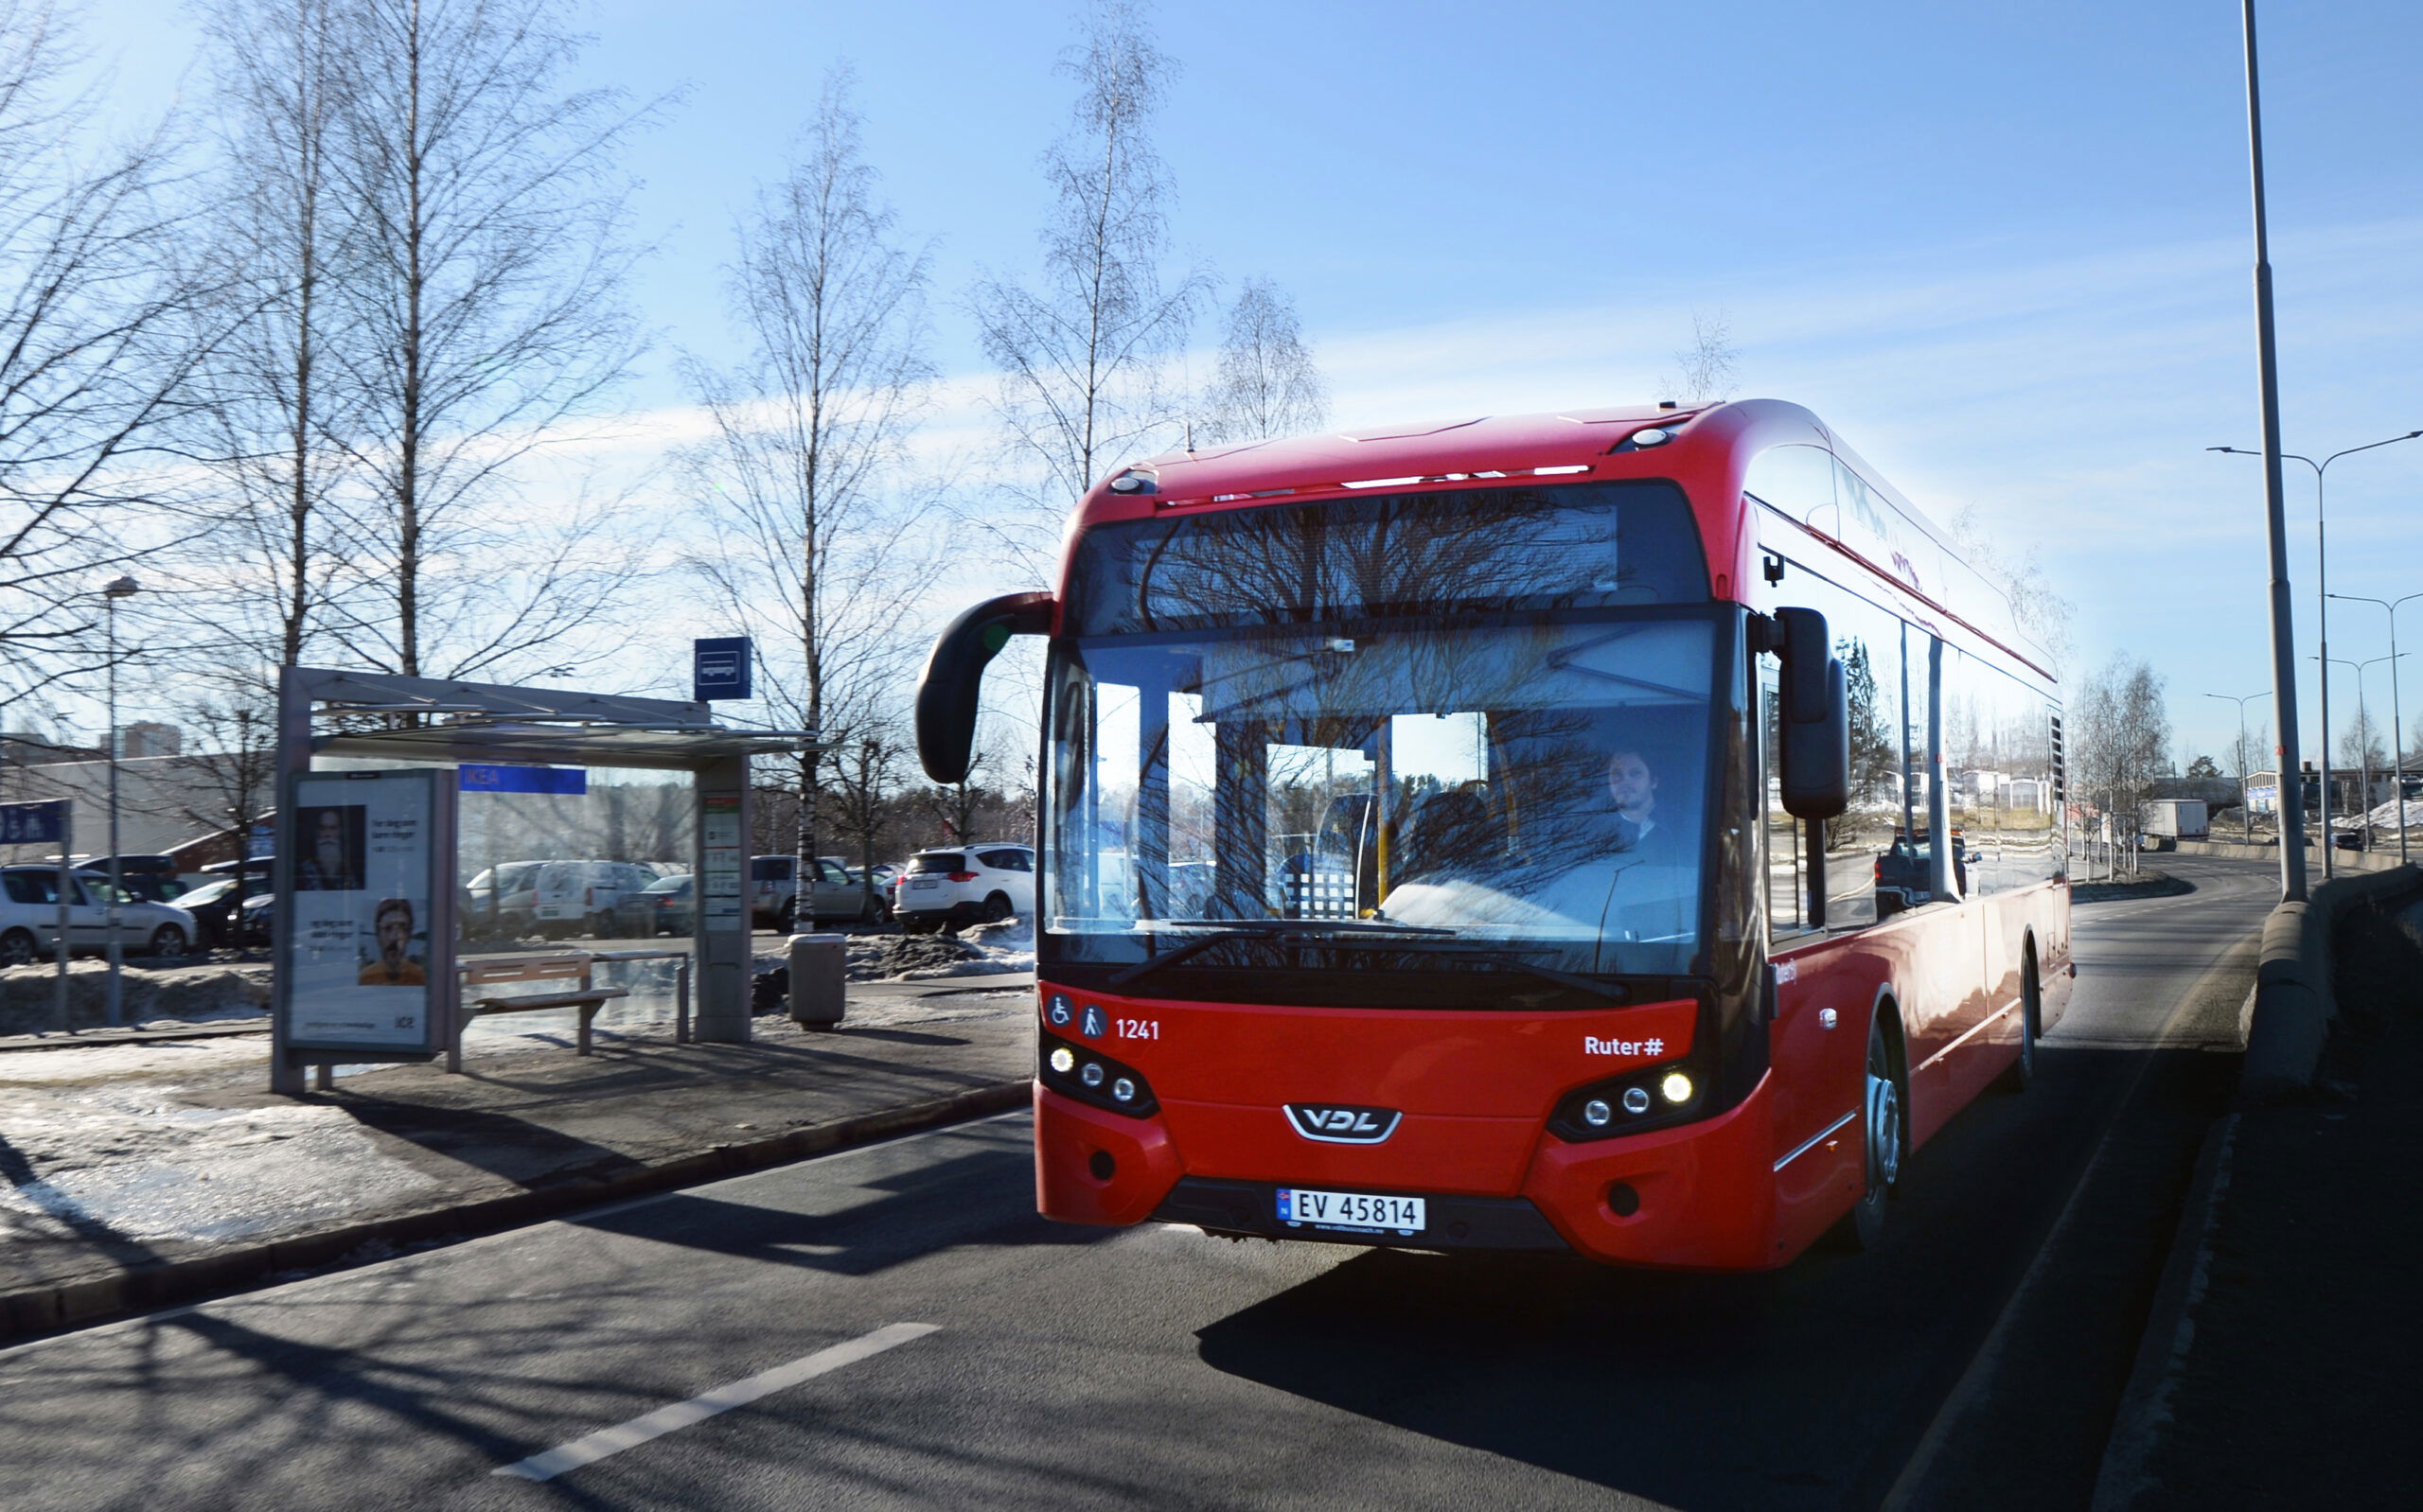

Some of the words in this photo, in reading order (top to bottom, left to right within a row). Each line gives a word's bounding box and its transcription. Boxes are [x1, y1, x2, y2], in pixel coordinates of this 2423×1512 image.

[464, 767, 500, 785] IKEA
[1117, 1018, 1158, 1040] 1241
[1584, 1036, 1664, 1056] Ruter#
[1302, 1109, 1378, 1131] VDL
[1299, 1193, 1327, 1218] EV
[1340, 1197, 1416, 1224] 45814
